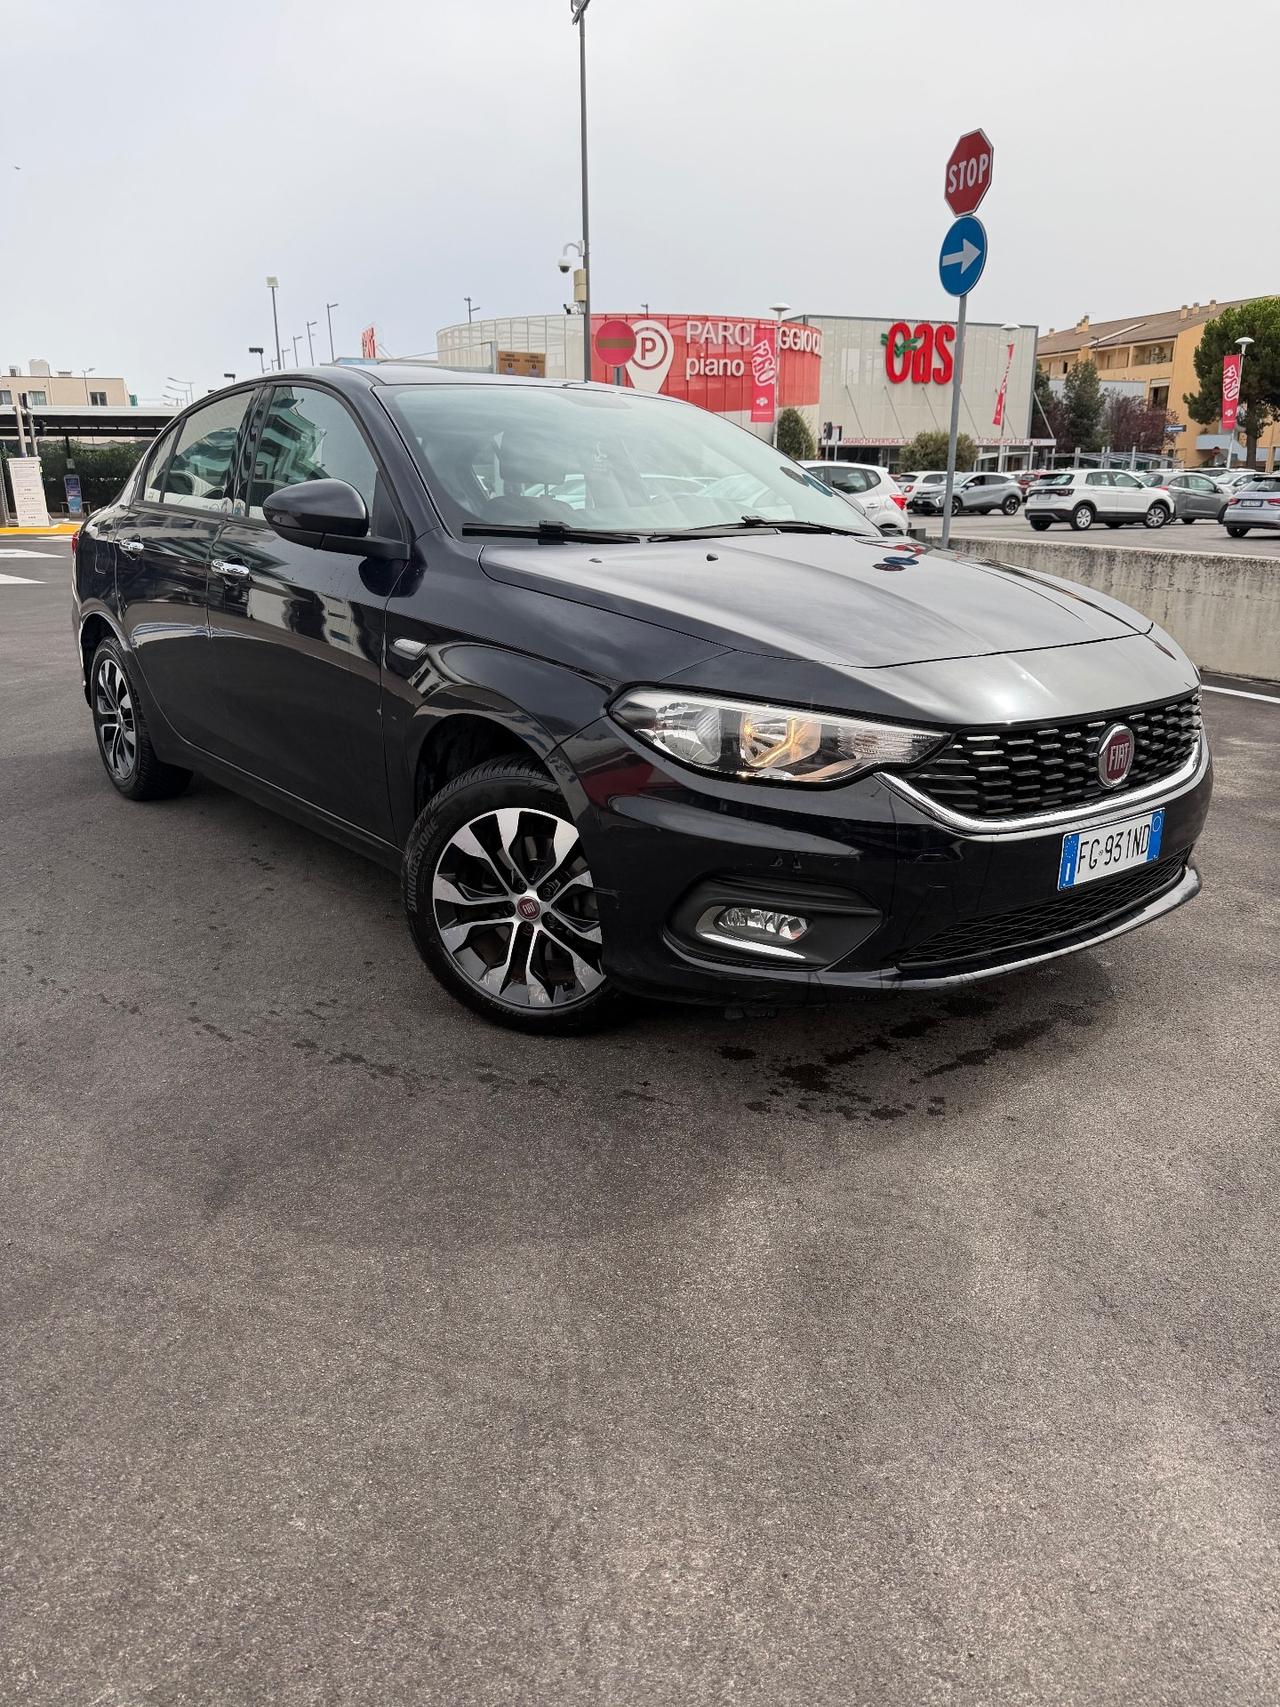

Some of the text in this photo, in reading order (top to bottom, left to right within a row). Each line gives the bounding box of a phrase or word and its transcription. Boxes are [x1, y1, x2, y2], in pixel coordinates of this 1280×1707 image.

[948, 154, 989, 193] STOP
[641, 337, 657, 360] P
[686, 320, 812, 352] PARCGGIO
[886, 321, 962, 384] Oas
[685, 353, 745, 381] piano
[1108, 742, 1130, 771] FIAT
[407, 816, 439, 912] BRIDGESTONE
[1077, 838, 1101, 874] FG
